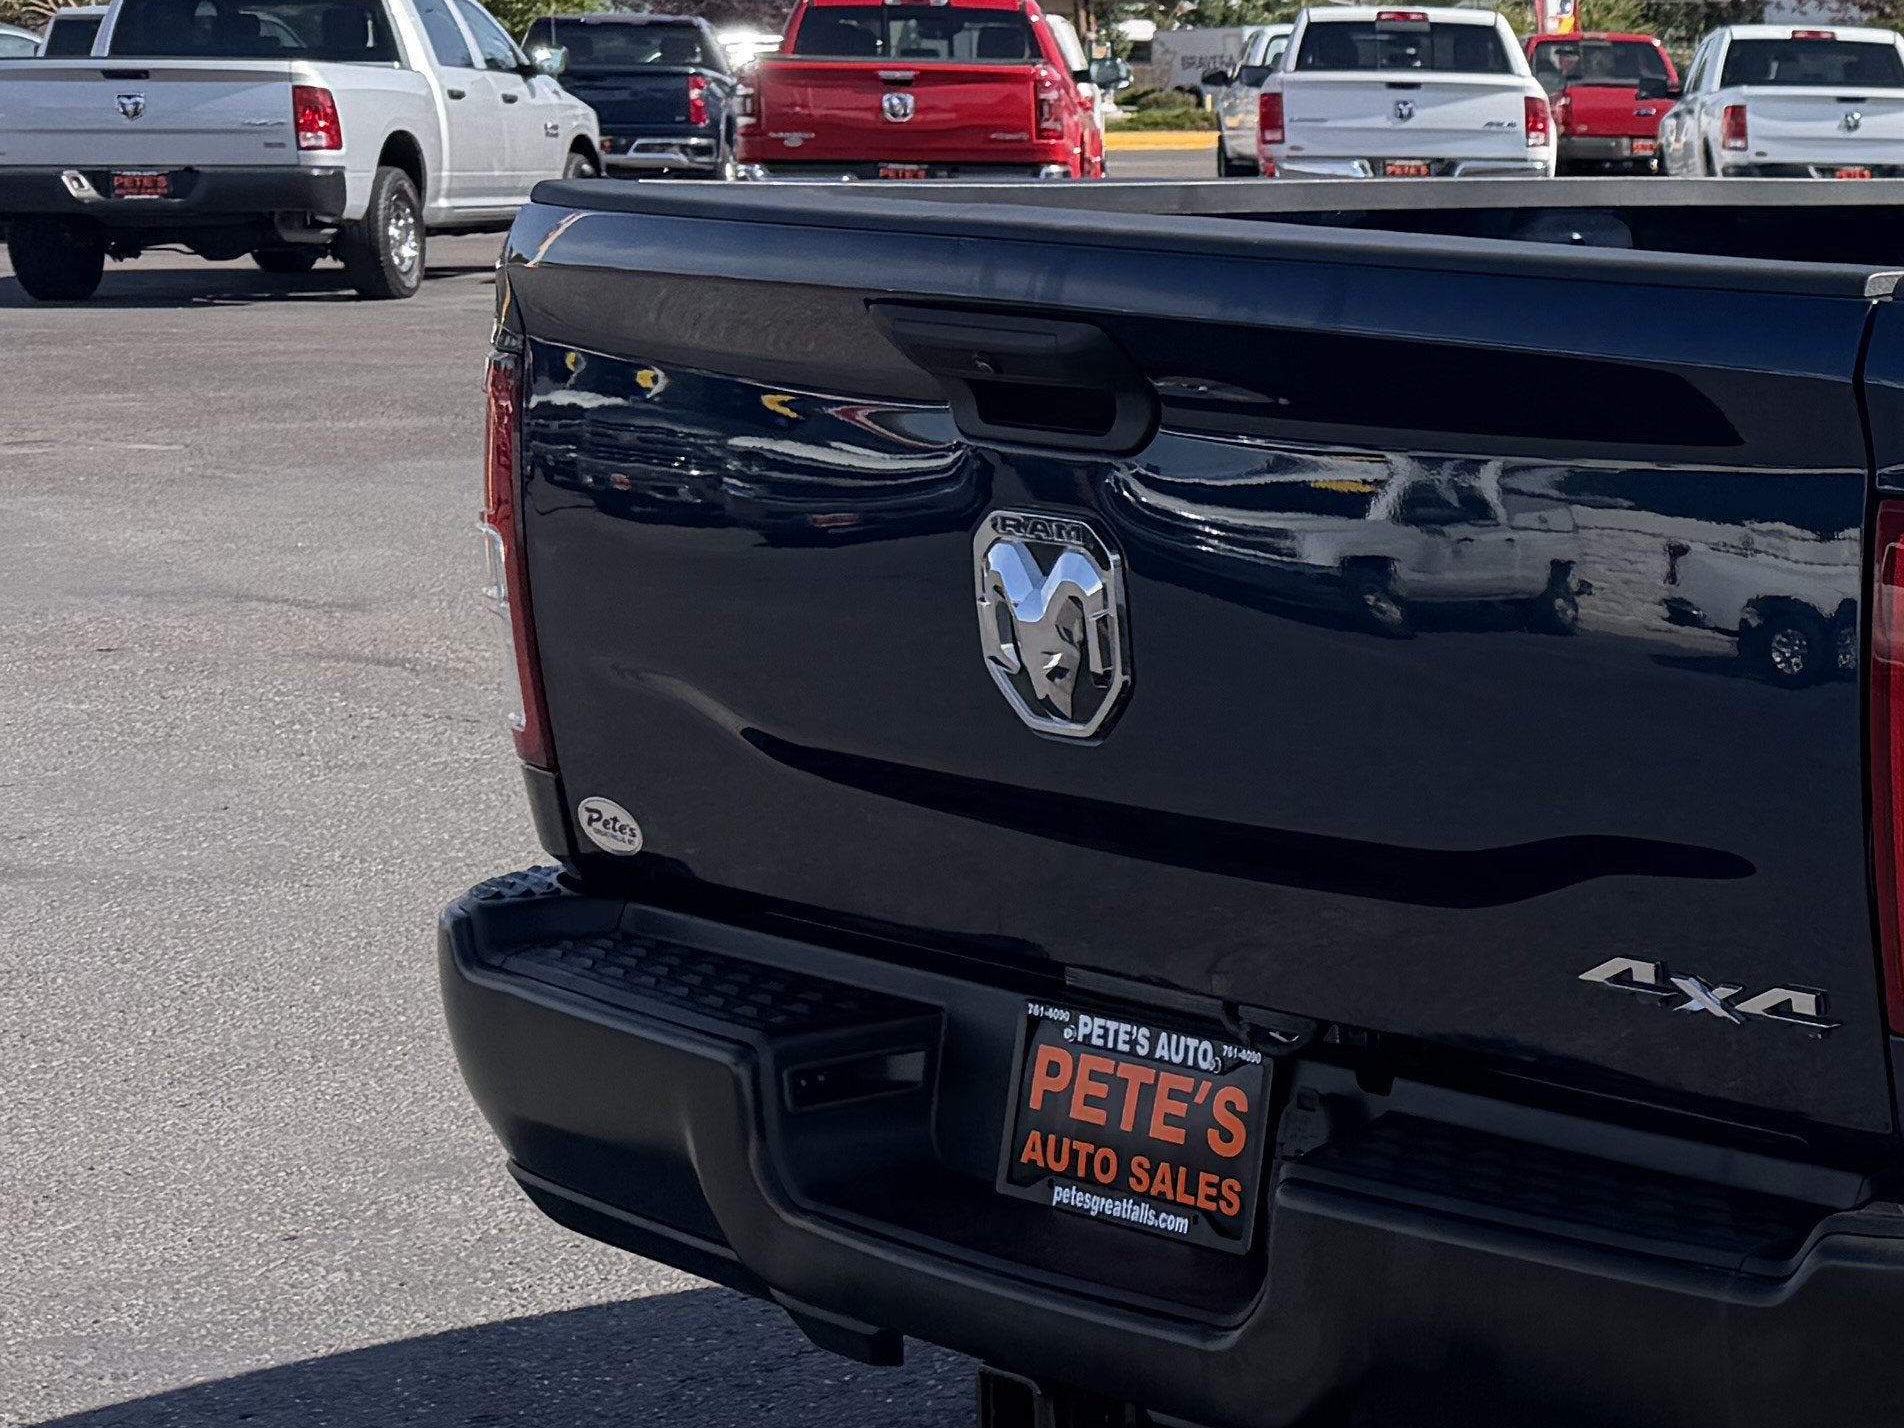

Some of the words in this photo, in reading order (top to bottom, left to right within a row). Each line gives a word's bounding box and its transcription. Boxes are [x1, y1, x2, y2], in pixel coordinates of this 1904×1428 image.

[997, 515, 1085, 545] RAM
[1077, 1013, 1151, 1056] PETE'S
[1154, 1031, 1214, 1068] AUTO
[1028, 1043, 1250, 1159] PETE'S
[1019, 1129, 1119, 1186] AUTO
[1128, 1155, 1243, 1218] SALES
[1051, 1184, 1190, 1235] petesgreatfalls.com
